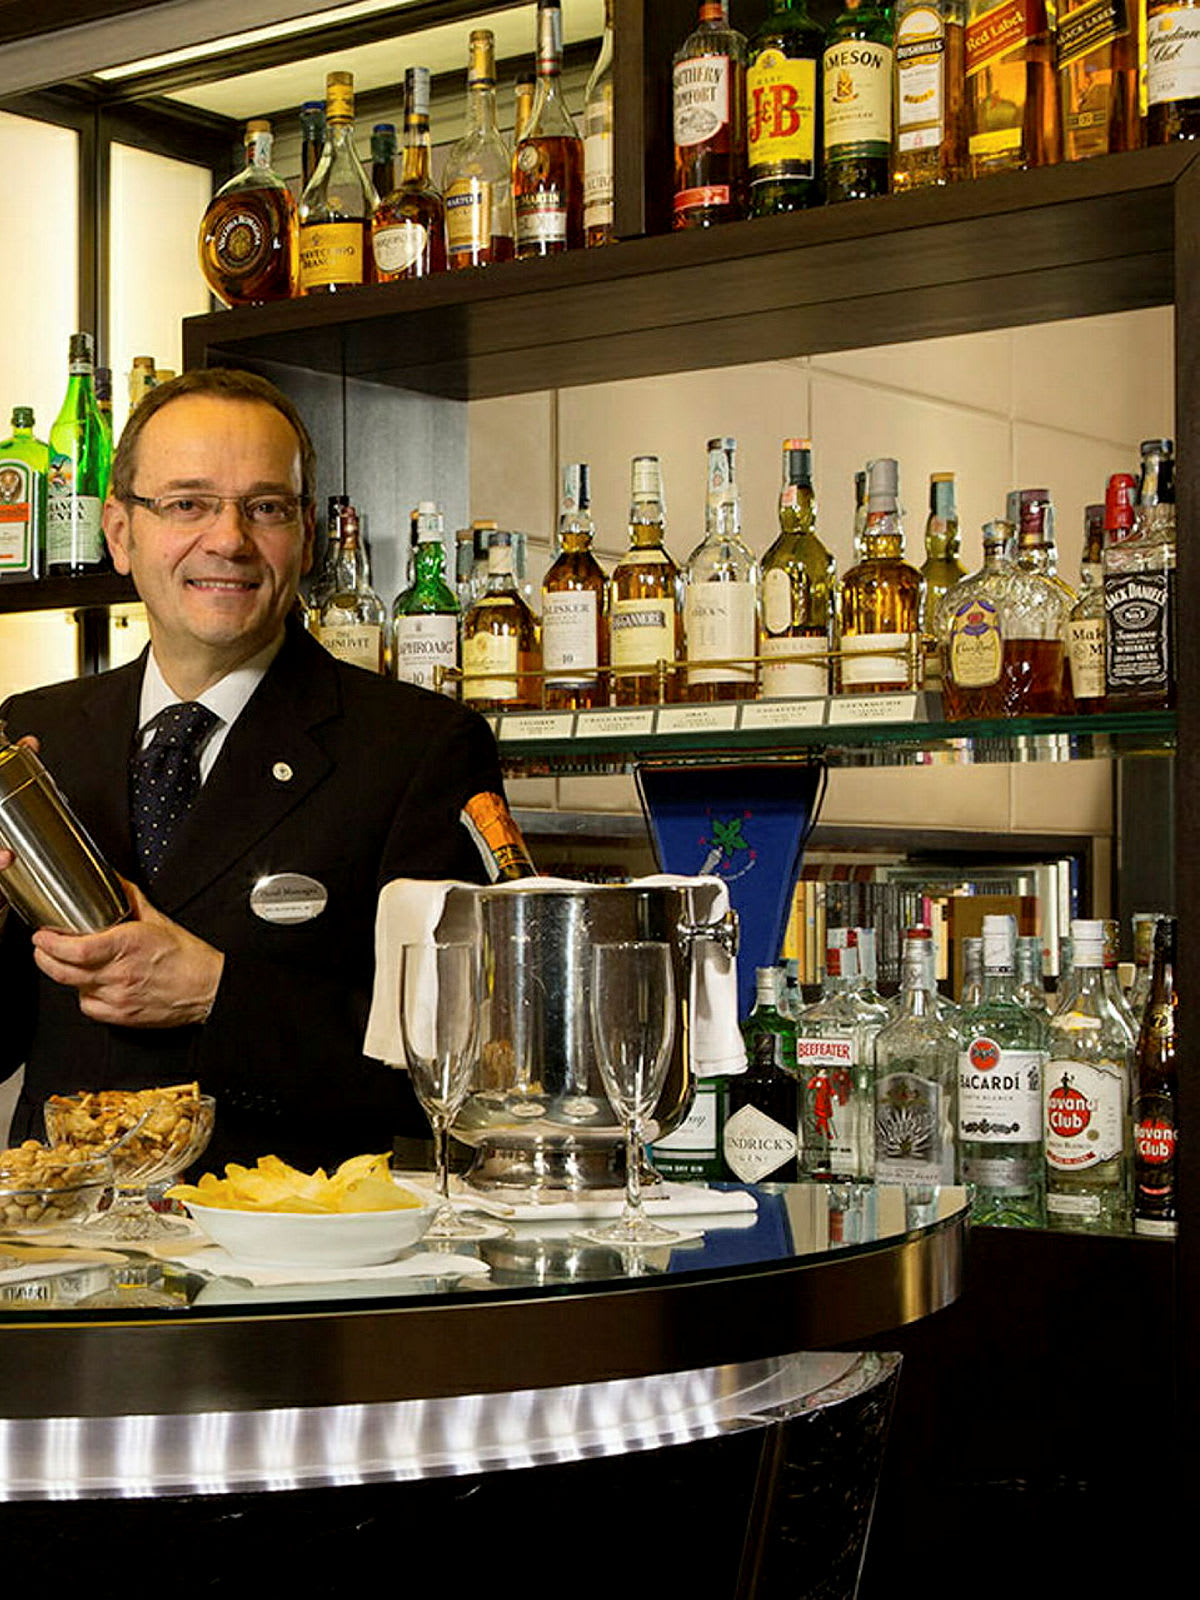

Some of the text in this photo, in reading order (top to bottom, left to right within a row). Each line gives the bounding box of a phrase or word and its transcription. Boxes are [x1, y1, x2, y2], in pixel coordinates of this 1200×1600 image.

[966, 11, 1023, 52] Red Label
[750, 84, 800, 144] J&B
[562, 653, 574, 665] 10
[412, 671, 425, 686] 10
[798, 1042, 851, 1059] BEEFEATER
[1050, 1111, 1083, 1128] Club
[1140, 1140, 1169, 1156] Club
